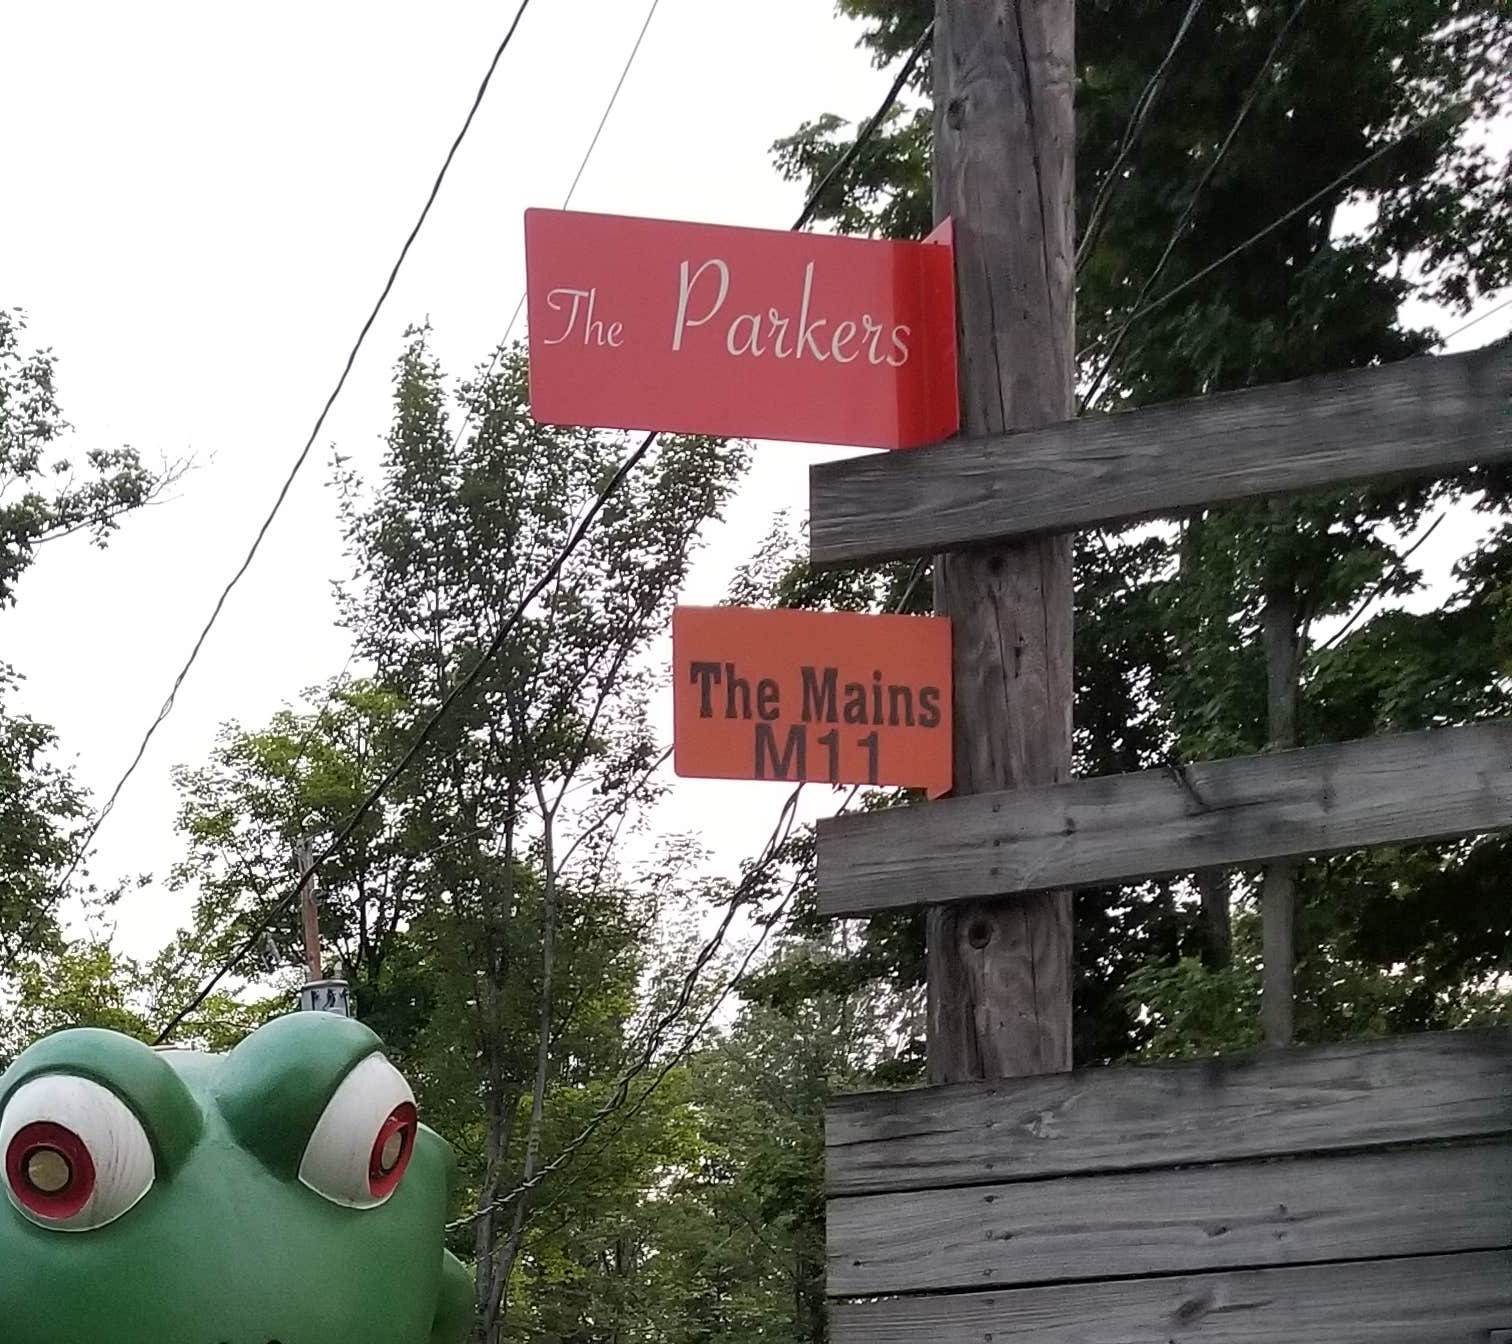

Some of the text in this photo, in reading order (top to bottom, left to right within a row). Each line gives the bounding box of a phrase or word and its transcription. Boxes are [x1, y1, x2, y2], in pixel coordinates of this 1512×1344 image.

[543, 258, 912, 368] The Parkers
[690, 661, 942, 729] The Mains
[754, 722, 880, 786] M11
